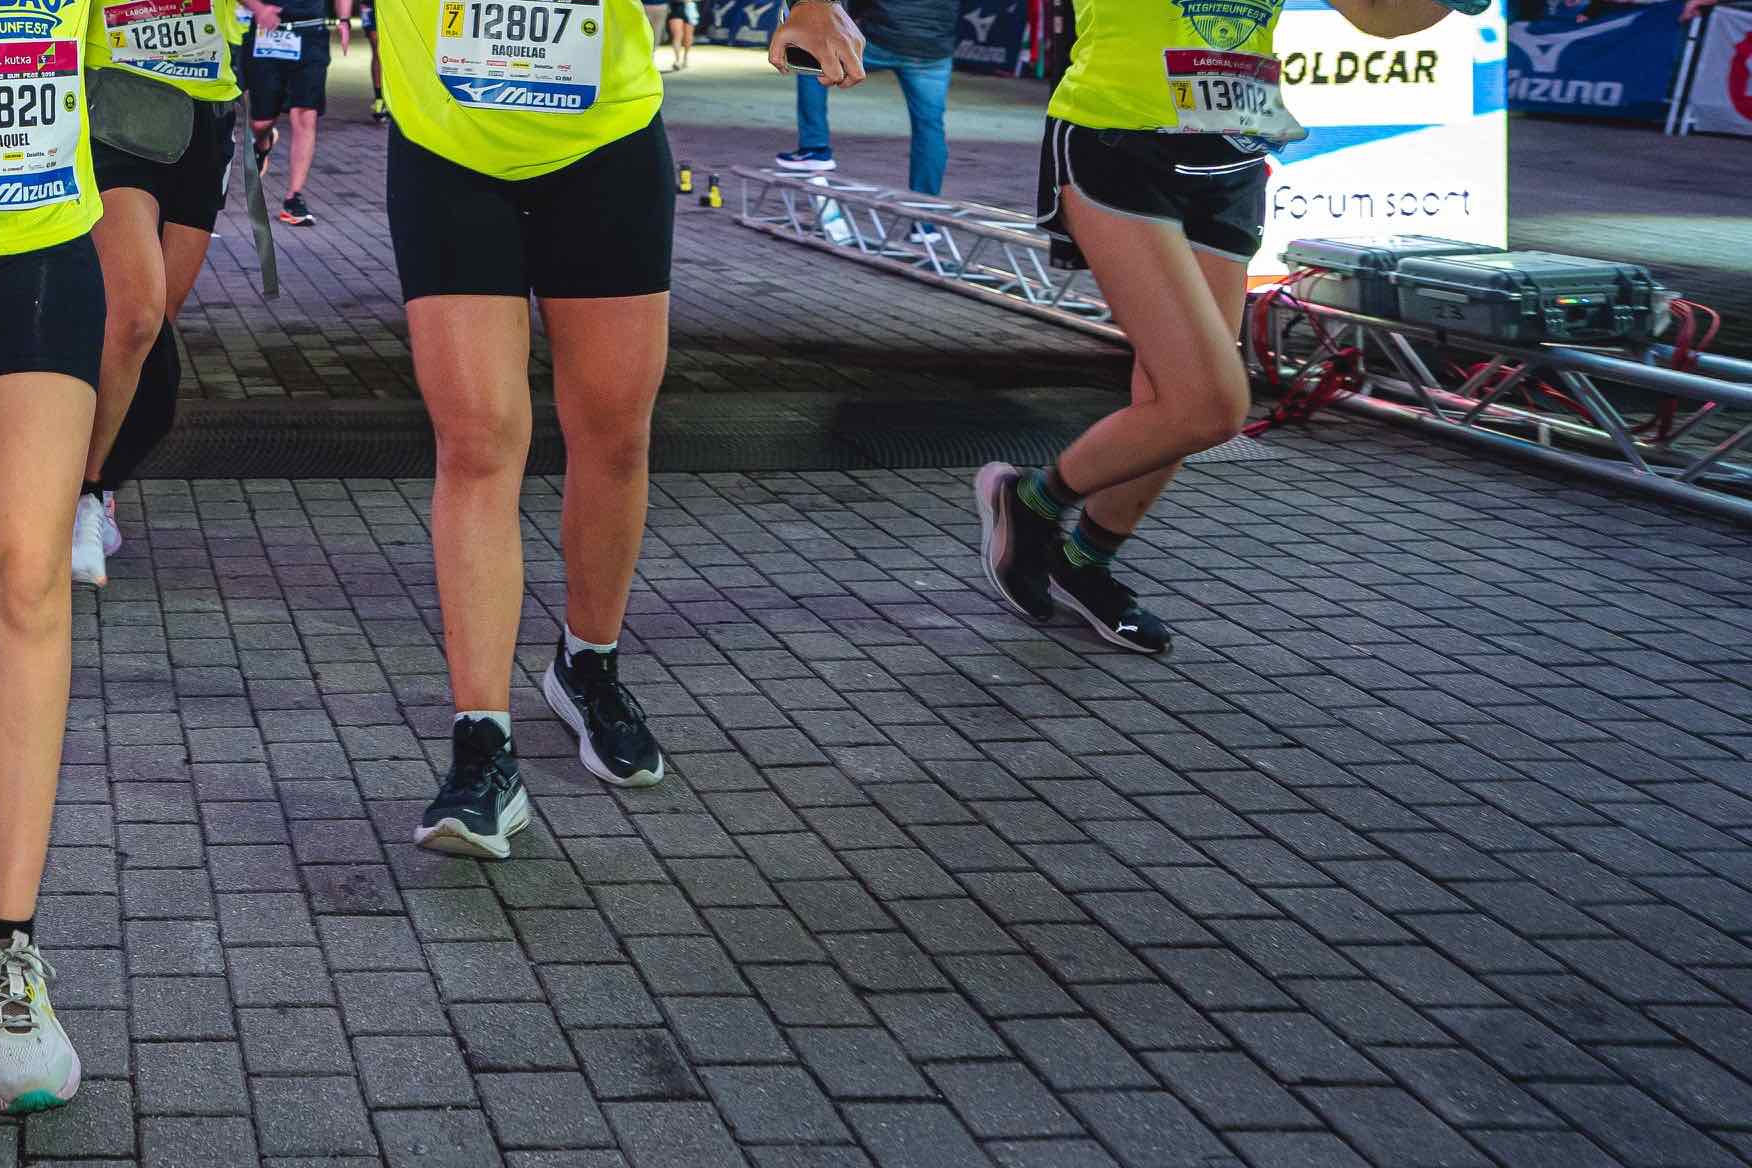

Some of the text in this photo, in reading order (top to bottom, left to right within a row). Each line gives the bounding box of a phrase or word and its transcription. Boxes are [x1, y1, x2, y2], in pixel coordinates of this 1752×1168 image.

[447, 11, 459, 29] 7
[471, 2, 574, 44] 12807
[131, 20, 197, 50] 12861
[4, 55, 32, 65] kutxa
[491, 44, 546, 59] RAQUELAG
[1272, 50, 1439, 84] OLDCAR
[1176, 88, 1187, 107] 7
